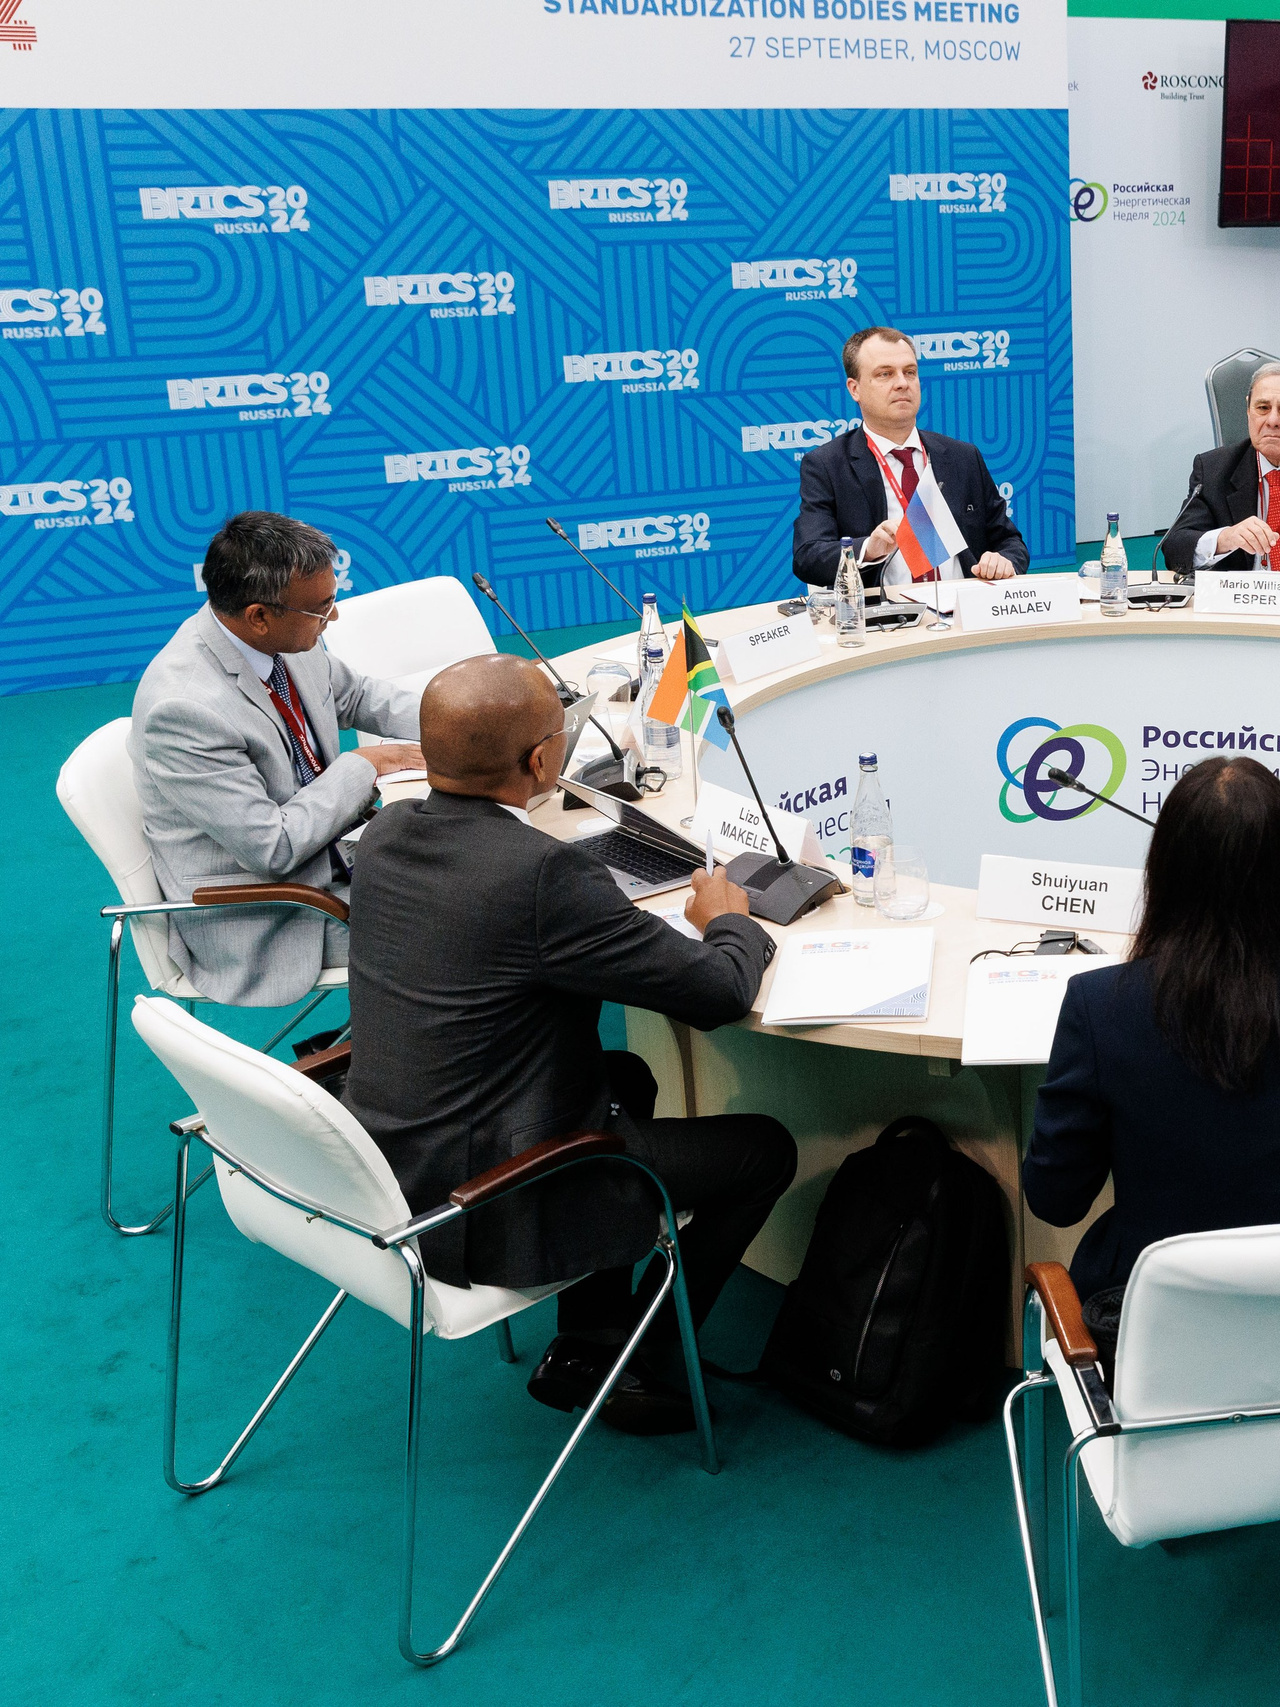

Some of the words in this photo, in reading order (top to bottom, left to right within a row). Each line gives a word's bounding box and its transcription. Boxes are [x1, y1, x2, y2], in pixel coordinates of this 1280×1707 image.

[543, 0, 806, 19] STANDARDIZATION
[813, 0, 908, 21] BODIES
[913, 1, 1020, 24] MEETING
[729, 36, 756, 58] 27
[766, 37, 916, 62] SEPTEMBER,
[923, 40, 1020, 62] MOSCOW
[1160, 92, 1188, 101] Building
[1189, 92, 1205, 100] Trust
[547, 178, 653, 210] BRICS
[889, 173, 977, 202] BRICS
[1113, 182, 1175, 193] Российская
[139, 185, 265, 219] BRICS
[938, 204, 978, 214] RUSSIA
[1113, 197, 1191, 209] Энергетическая
[608, 211, 655, 223] RUSSIA
[1113, 211, 1150, 222] Неделя
[1152, 211, 1186, 226] 2024
[214, 222, 269, 234] RUSSIA
[731, 259, 825, 290] BRICS
[363, 273, 477, 307] BRICS
[785, 289, 827, 302] RUSSIA
[429, 305, 480, 318] RUSSIA
[2, 325, 63, 340] RUSSIA
[905, 331, 981, 361] RICS
[563, 348, 666, 384] BRICS
[943, 360, 982, 372] RUSSIA
[166, 373, 289, 410] BRICS
[621, 381, 667, 394] RUSSIA
[239, 407, 293, 421] RUSSIA
[741, 419, 833, 453] BRICS
[384, 447, 493, 484] BRICS
[448, 479, 497, 494] RUSSIA
[0, 480, 87, 517] ICS
[33, 515, 92, 531] RUSSIA
[578, 515, 678, 551] BRICS
[635, 545, 679, 559] RUSSIA
[1219, 578, 1250, 591] Mario
[1004, 587, 1037, 601] Anton
[1233, 592, 1278, 606] ESPER
[991, 601, 1052, 617] SHALAEV
[748, 624, 791, 647] SPEAKER
[774, 776, 848, 814] йская
[739, 806, 760, 826] Lizo
[720, 821, 769, 853] MAKELE
[1031, 871, 1109, 893] Shuiyuan
[1041, 894, 1096, 915] CHEN
